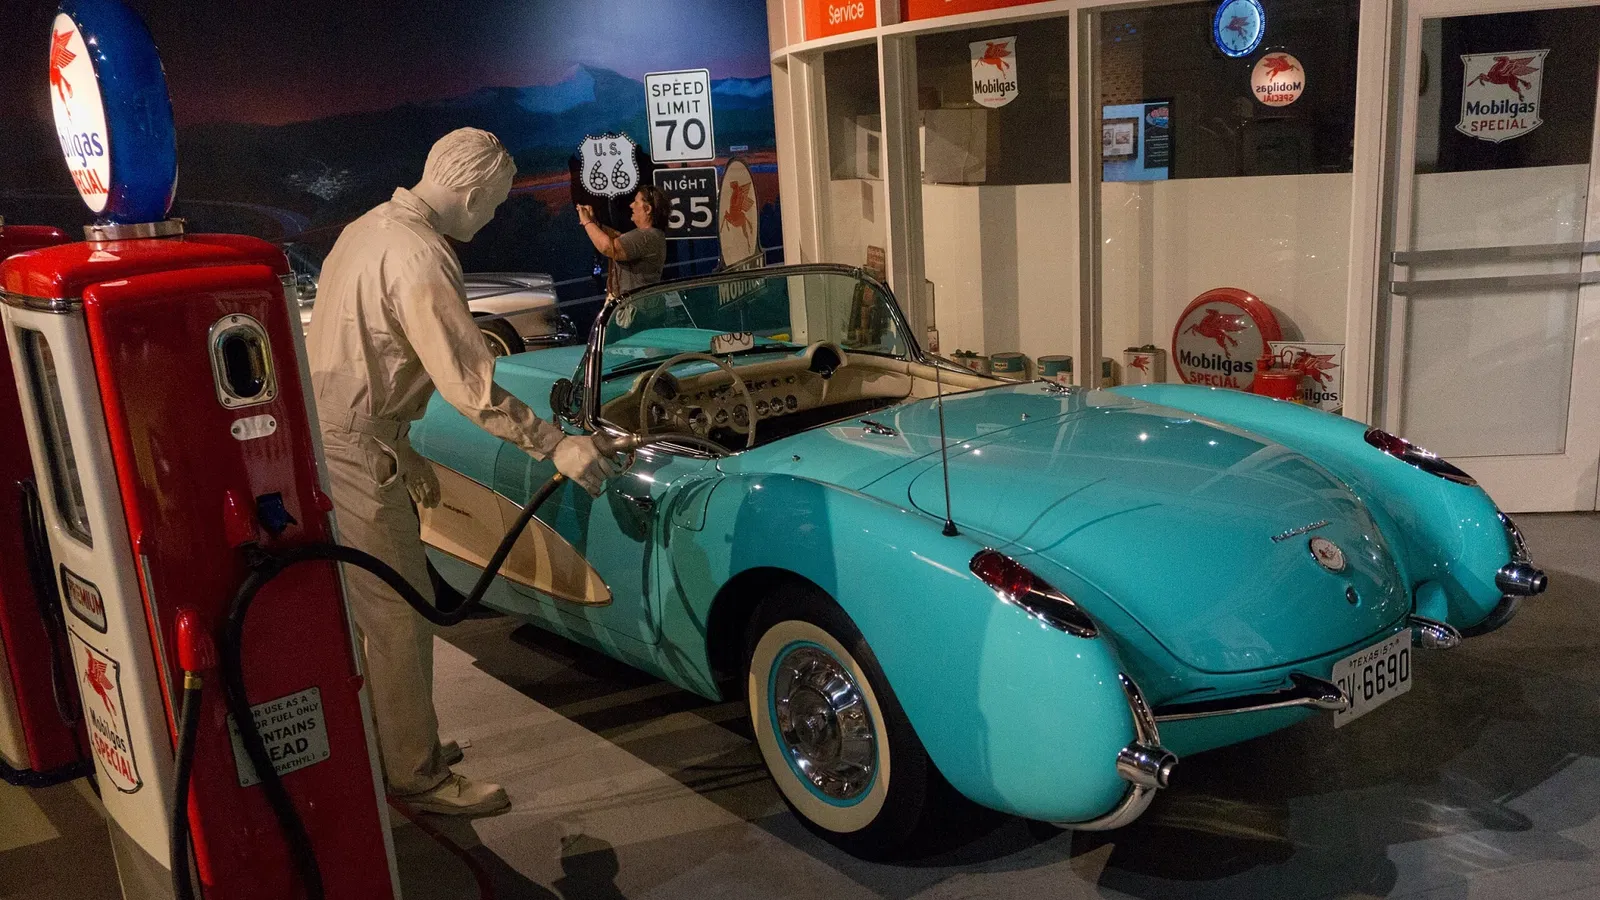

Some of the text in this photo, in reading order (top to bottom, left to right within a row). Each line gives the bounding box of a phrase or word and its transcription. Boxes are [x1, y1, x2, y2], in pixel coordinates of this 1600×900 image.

[828, 2, 864, 25] Service
[652, 81, 704, 97] SPEED
[974, 79, 1016, 97] Mobilgas
[657, 100, 701, 115] LIMIT
[1465, 99, 1536, 118] Mobilgas
[655, 118, 706, 152] 70
[1471, 119, 1528, 132] SPECIAL
[593, 142, 621, 157] U.S.
[589, 158, 631, 191] 66
[663, 178, 707, 191] NIGHT
[667, 196, 713, 229] 65
[1180, 350, 1253, 376] Mobilgas
[1189, 371, 1240, 389] SPECIAL
[1304, 388, 1338, 404] ilgas
[67, 577, 104, 616] PREMIUM
[1353, 649, 1379, 669] TEXAS
[264, 704, 283, 715] USE
[286, 697, 298, 708] AS
[301, 695, 308, 703] A
[271, 712, 295, 724] FUEL
[296, 703, 319, 716] ONLY
[89, 707, 127, 753] Mobilgas
[263, 718, 316, 744] NTAINS
[93, 732, 136, 784] SPECIAL
[270, 737, 309, 761] EAD
